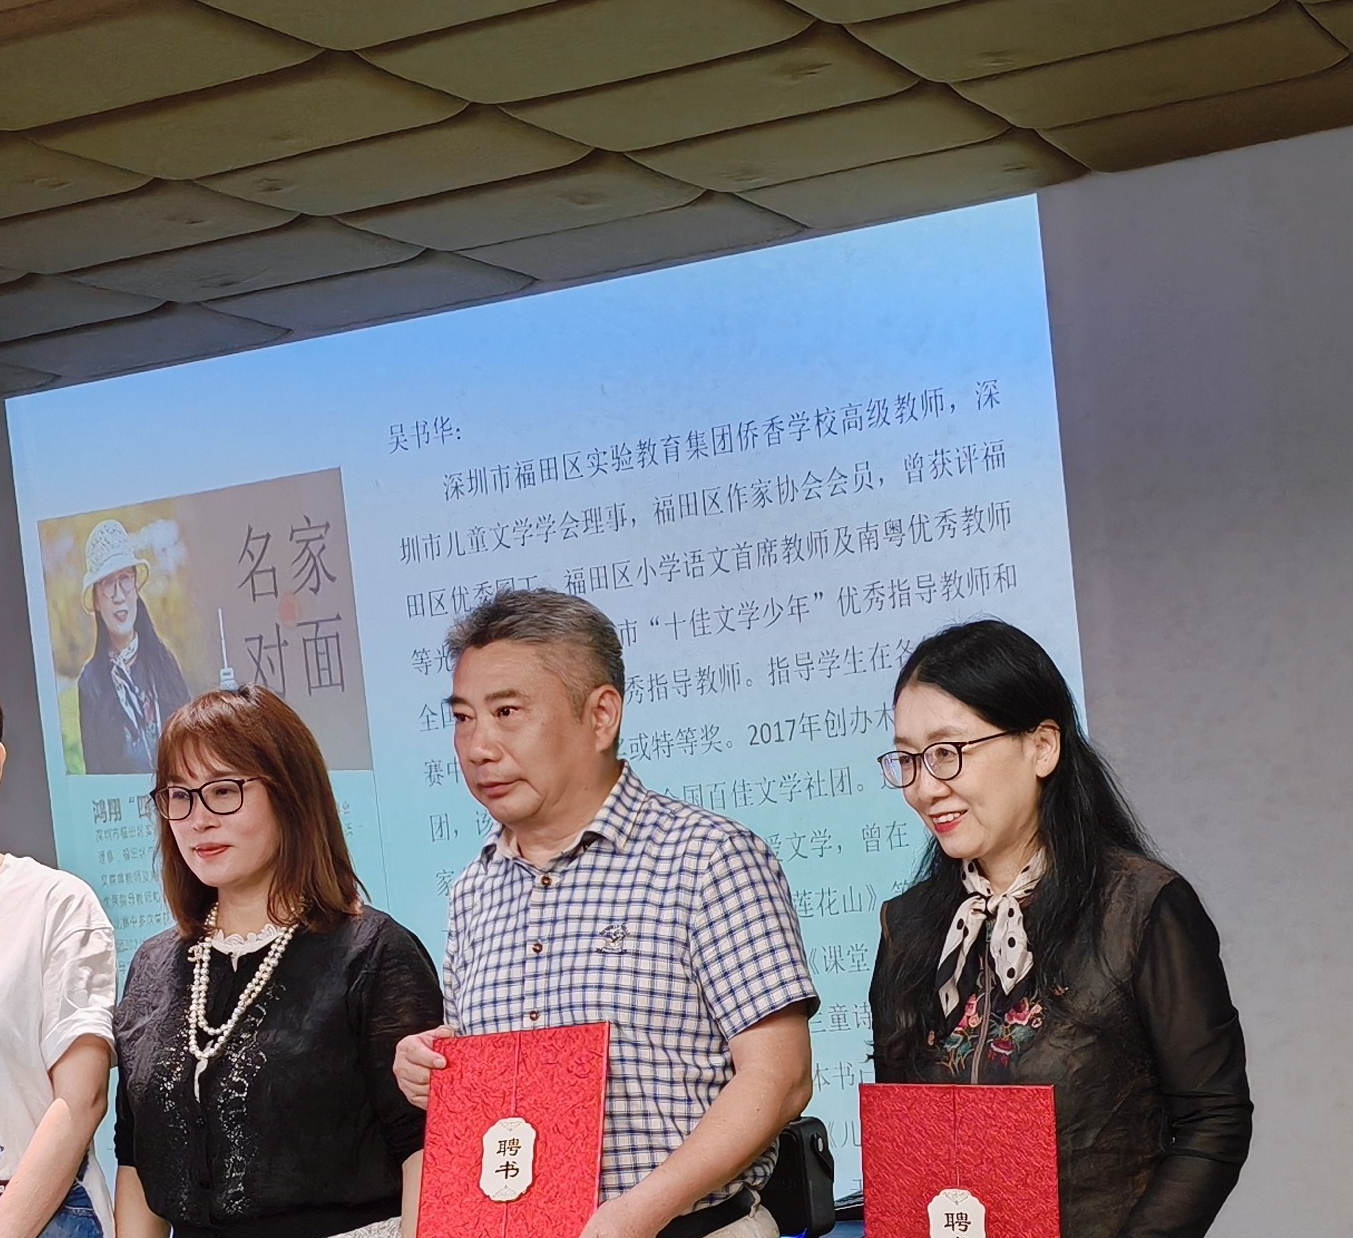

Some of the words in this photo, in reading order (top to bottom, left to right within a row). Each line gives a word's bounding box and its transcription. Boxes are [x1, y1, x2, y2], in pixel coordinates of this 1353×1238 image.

[237, 514, 337, 602] 名家
[244, 612, 345, 698] 对面
[495, 1137, 521, 1179] 聘书
